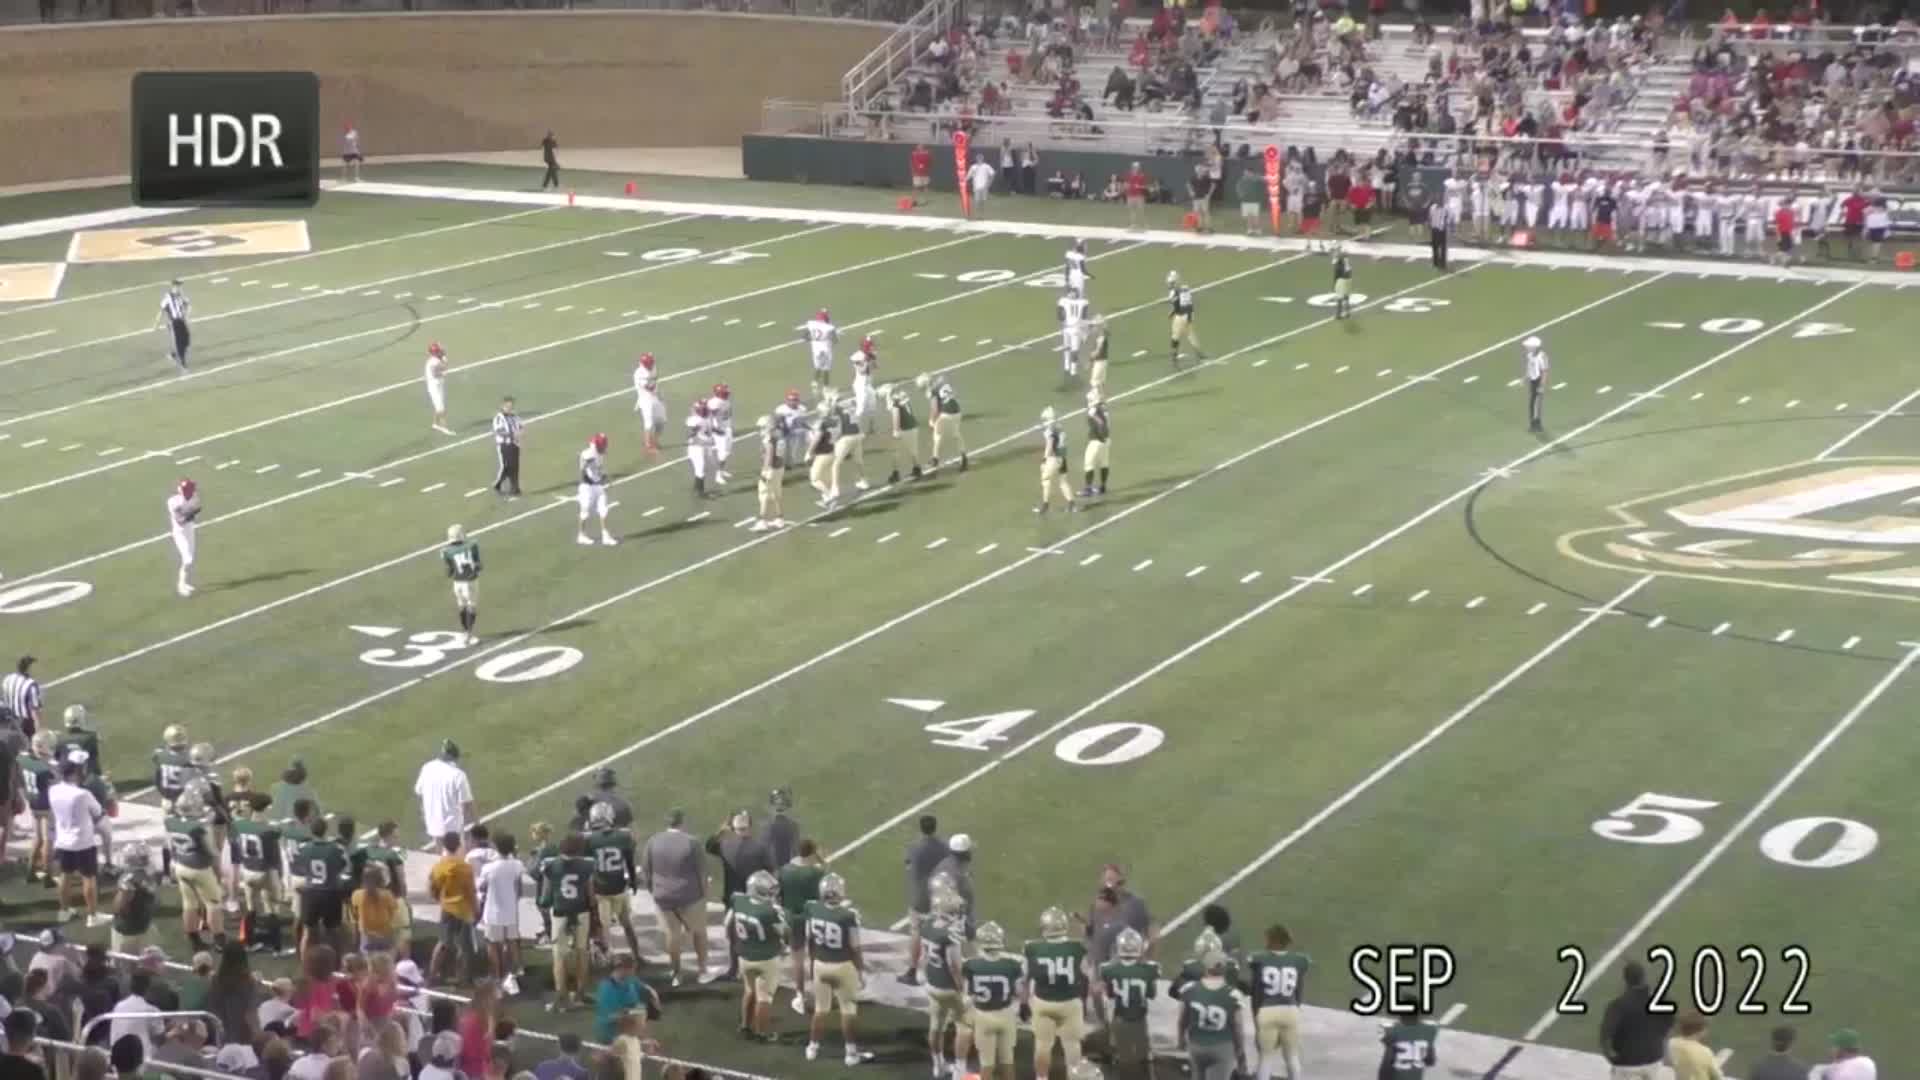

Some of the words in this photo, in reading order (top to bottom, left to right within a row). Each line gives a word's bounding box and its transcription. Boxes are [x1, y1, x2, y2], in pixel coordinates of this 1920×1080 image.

[311, 859, 327, 885] 9
[595, 847, 621, 873] 12
[560, 874, 578, 899] 6
[811, 917, 843, 949] 58
[1037, 956, 1084, 985] 74
[1261, 966, 1298, 997] 98
[972, 975, 1009, 1001] 57
[1111, 977, 1147, 1009] 47
[1190, 1001, 1227, 1031] 79
